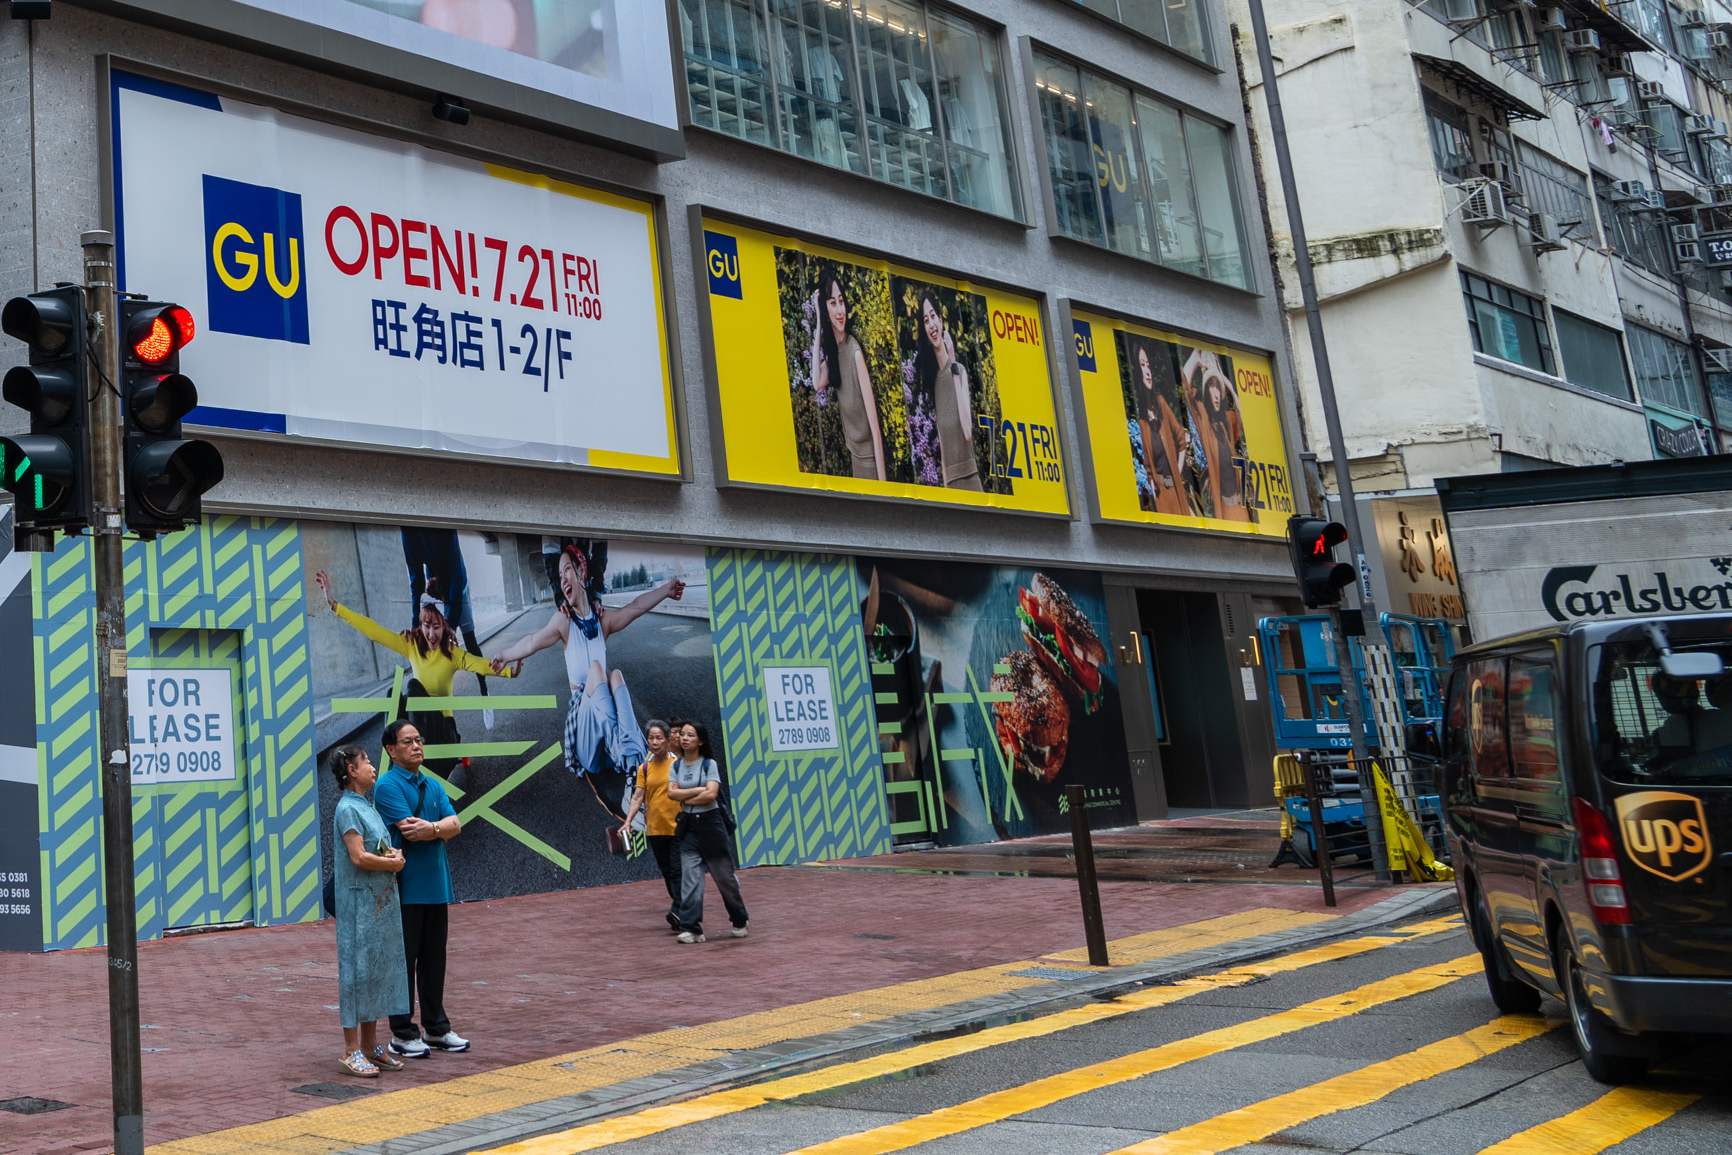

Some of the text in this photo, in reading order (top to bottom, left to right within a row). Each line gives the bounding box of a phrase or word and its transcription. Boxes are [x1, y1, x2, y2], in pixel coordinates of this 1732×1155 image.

[213, 222, 300, 299] GU
[325, 205, 600, 312] OPEN! 7.21 FRI
[708, 249, 739, 282] GU
[564, 292, 602, 321] 11:00
[992, 310, 1040, 346] OPEN!
[1074, 333, 1093, 358] GU
[1237, 368, 1271, 398] OPEN!
[978, 414, 1058, 480] 7.21 FRI
[1035, 460, 1060, 483] 11:00
[1231, 456, 1289, 511] 7.21 FRI
[1272, 495, 1292, 514] 11:00
[1408, 593, 1465, 618] WING SHIN
[148, 678, 201, 707] FOR
[781, 673, 815, 695] FOR
[774, 700, 828, 722] LEASE
[129, 714, 221, 744] LEASE
[779, 727, 830, 744] 2789 0908
[177, 751, 221, 773] 0908
[1626, 819, 1704, 867] ups
[8, 872, 28, 882] 0381
[11, 888, 30, 898] 5618
[11, 904, 31, 914] 5656
